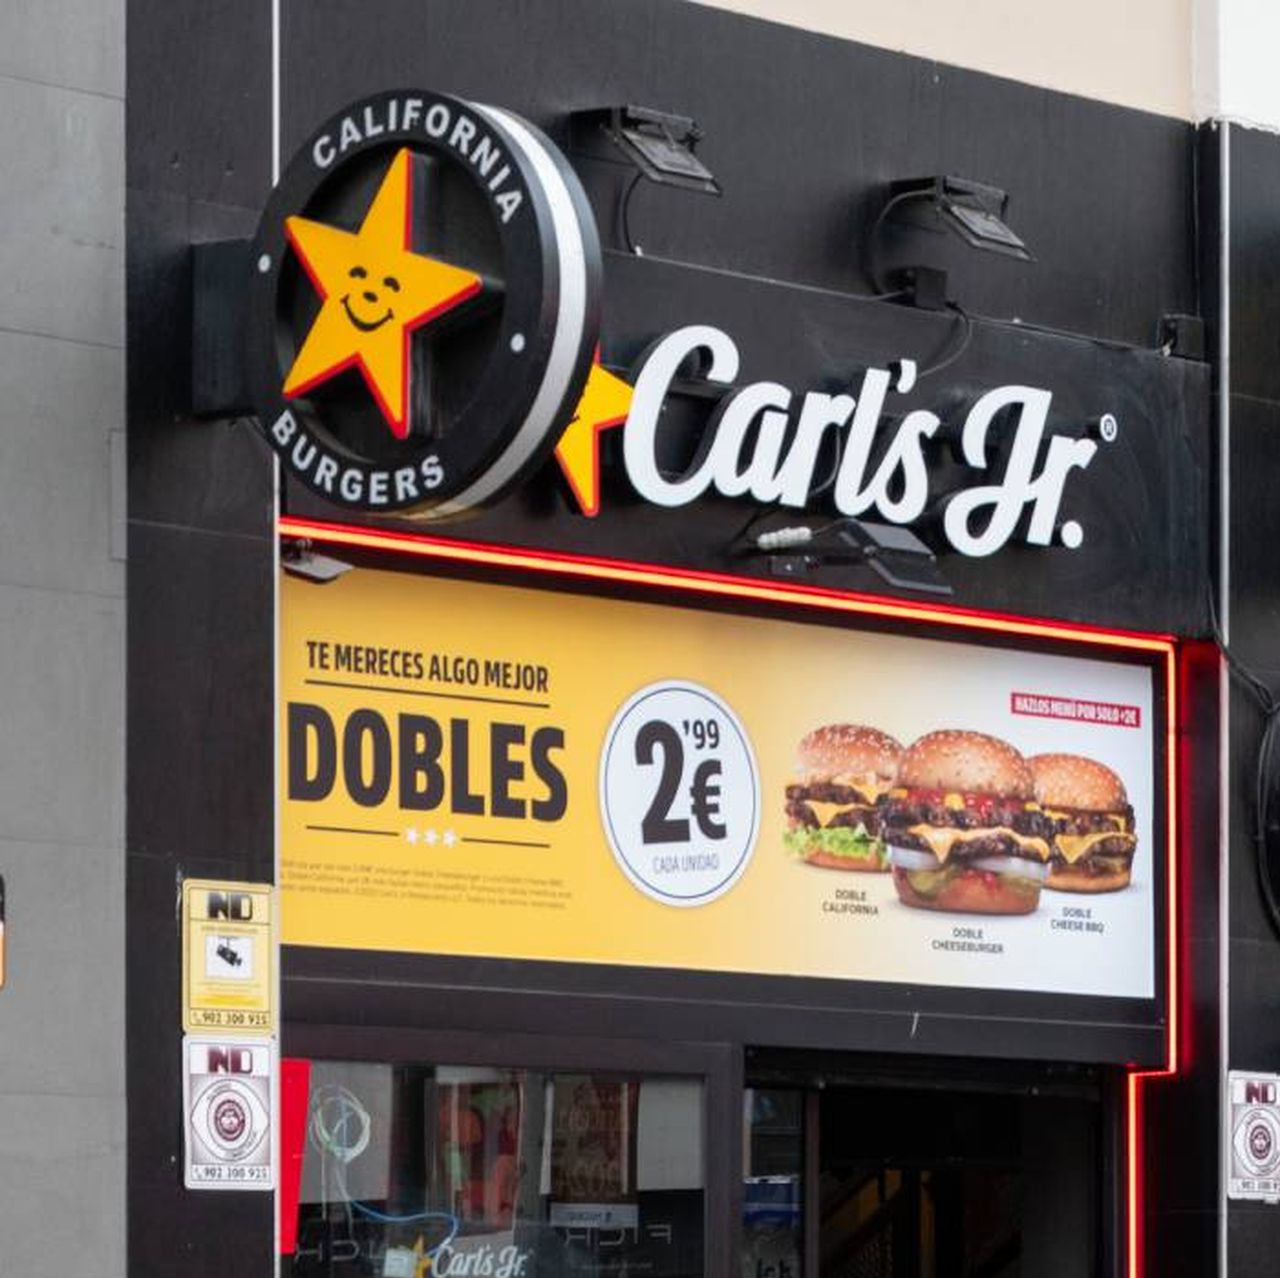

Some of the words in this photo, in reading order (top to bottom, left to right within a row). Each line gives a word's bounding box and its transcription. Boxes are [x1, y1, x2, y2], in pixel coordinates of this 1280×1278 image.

[312, 99, 523, 223] CALIFORNIA
[623, 325, 941, 524] Carl's
[272, 410, 444, 504] BURGERS
[306, 641, 331, 671] TE
[334, 644, 424, 680] MERECES
[428, 657, 480, 687] ALGO
[484, 661, 549, 693] MEJOR
[286, 701, 569, 823] DOBLES
[835, 888, 867, 903] DOBLE
[821, 902, 879, 917] CALIFORNIA
[1062, 906, 1092, 919] DOBLE
[1050, 919, 1084, 933] CHEESE
[952, 928, 984, 940] DOBLE
[931, 940, 1004, 954] CHEESEBURGER
